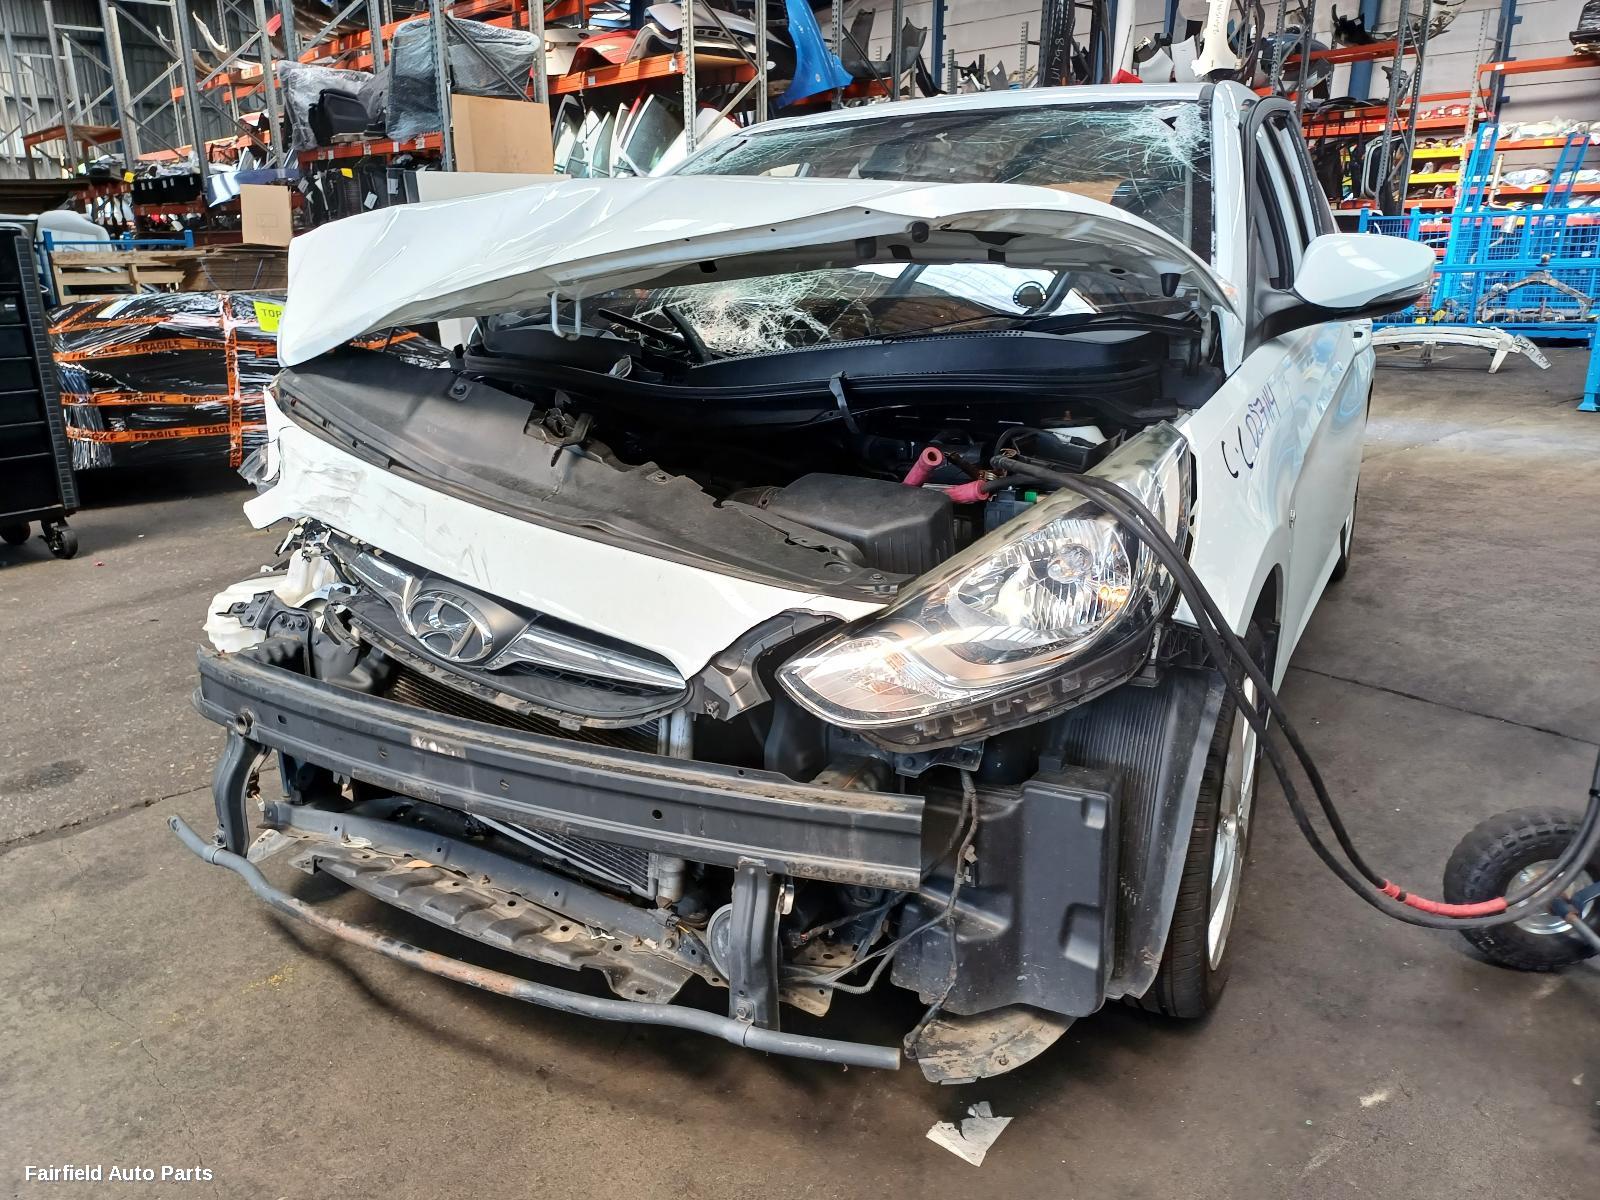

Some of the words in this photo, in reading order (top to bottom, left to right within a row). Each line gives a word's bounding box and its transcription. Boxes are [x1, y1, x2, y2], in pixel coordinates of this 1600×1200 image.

[261, 308, 282, 318] TOP
[135, 339, 181, 353] FRAGILE
[134, 430, 180, 440] FRAGILE
[198, 425, 230, 435] FRAGI
